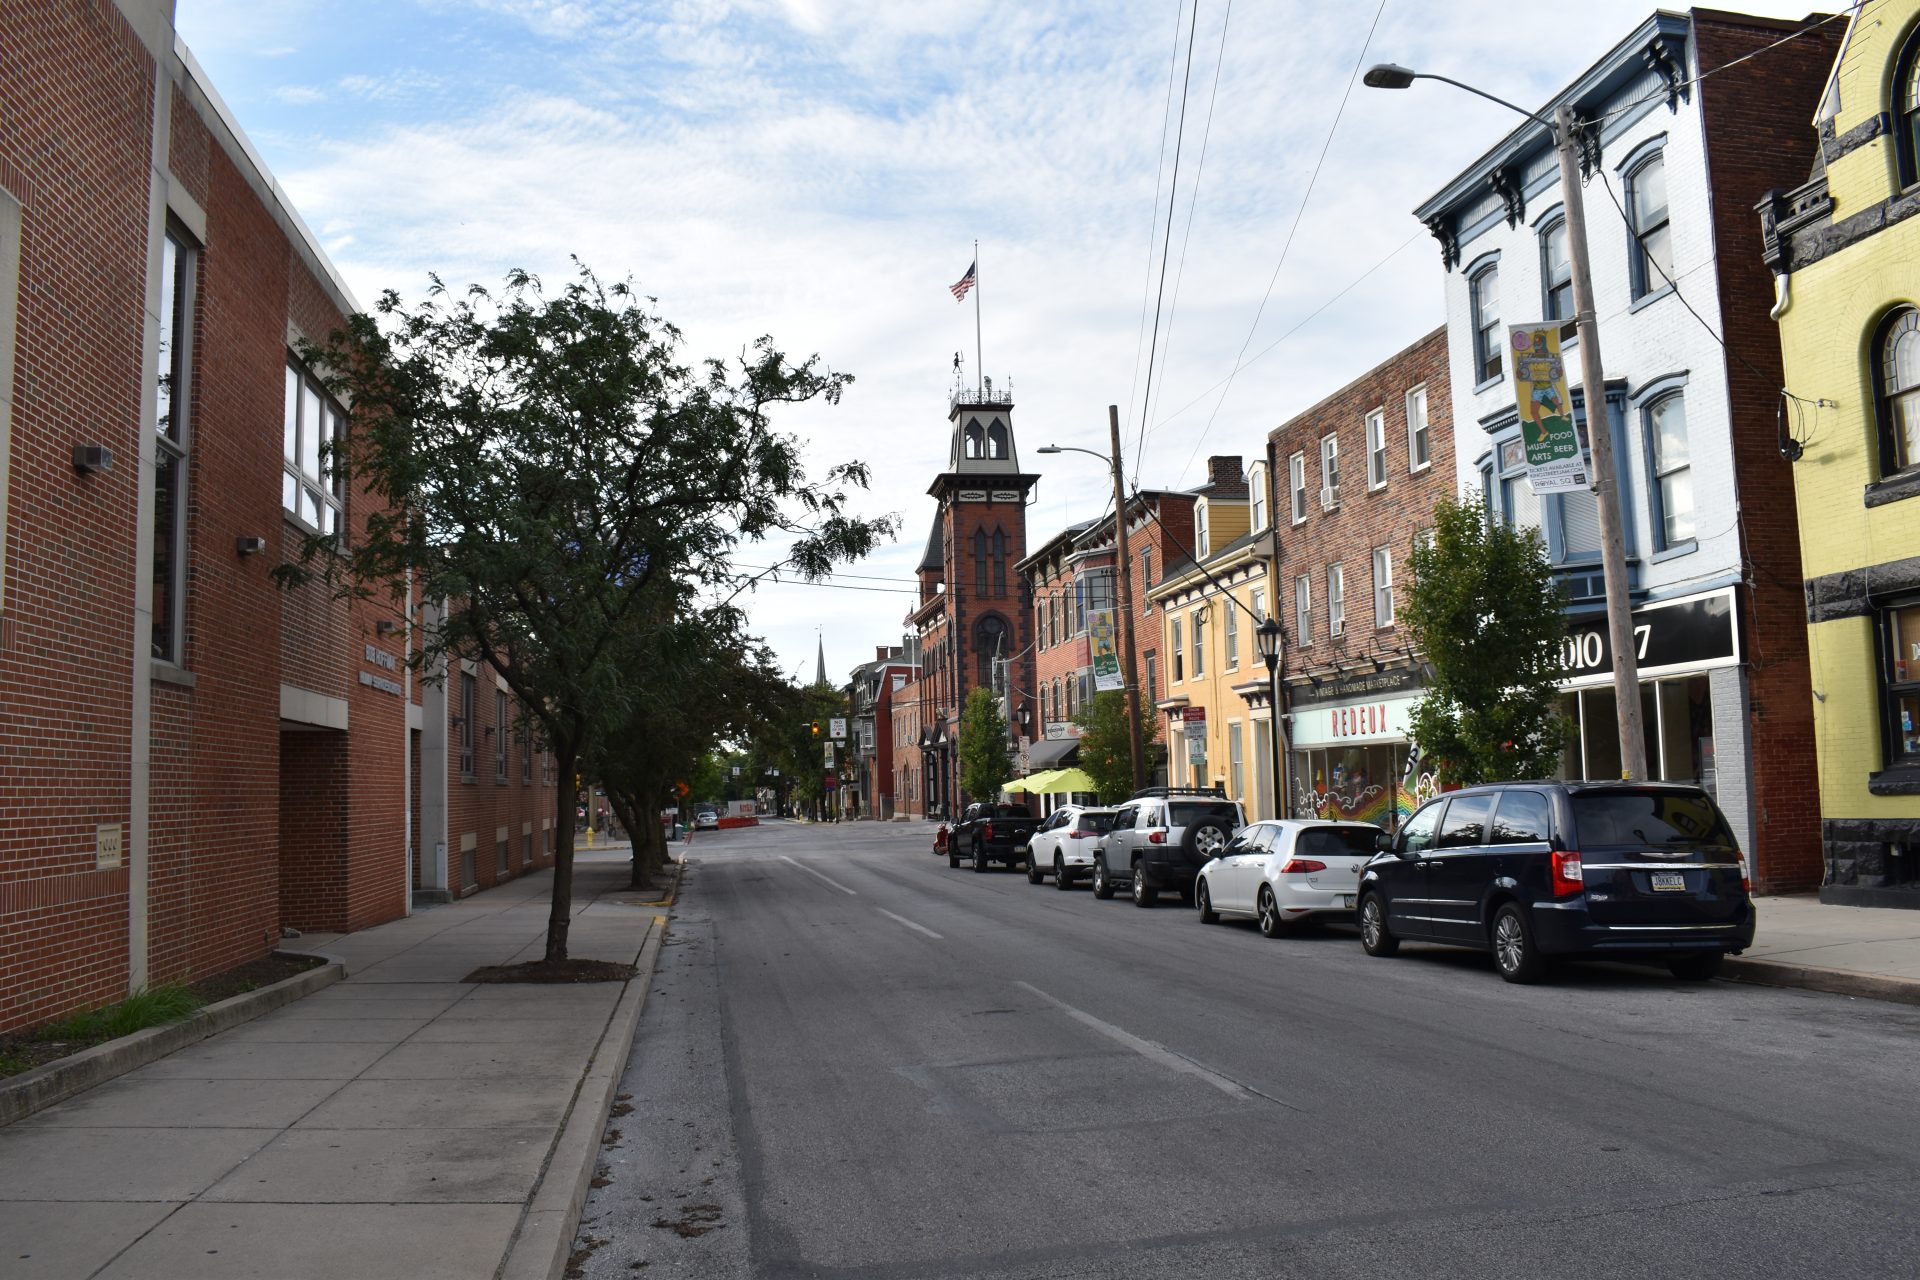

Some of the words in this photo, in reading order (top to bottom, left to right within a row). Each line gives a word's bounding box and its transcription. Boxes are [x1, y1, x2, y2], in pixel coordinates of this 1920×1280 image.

[1549, 431, 1573, 441] FOOD
[1526, 442, 1550, 451] MUSIC
[1531, 452, 1552, 461] ARTS
[1331, 704, 1386, 737] REDEUX
